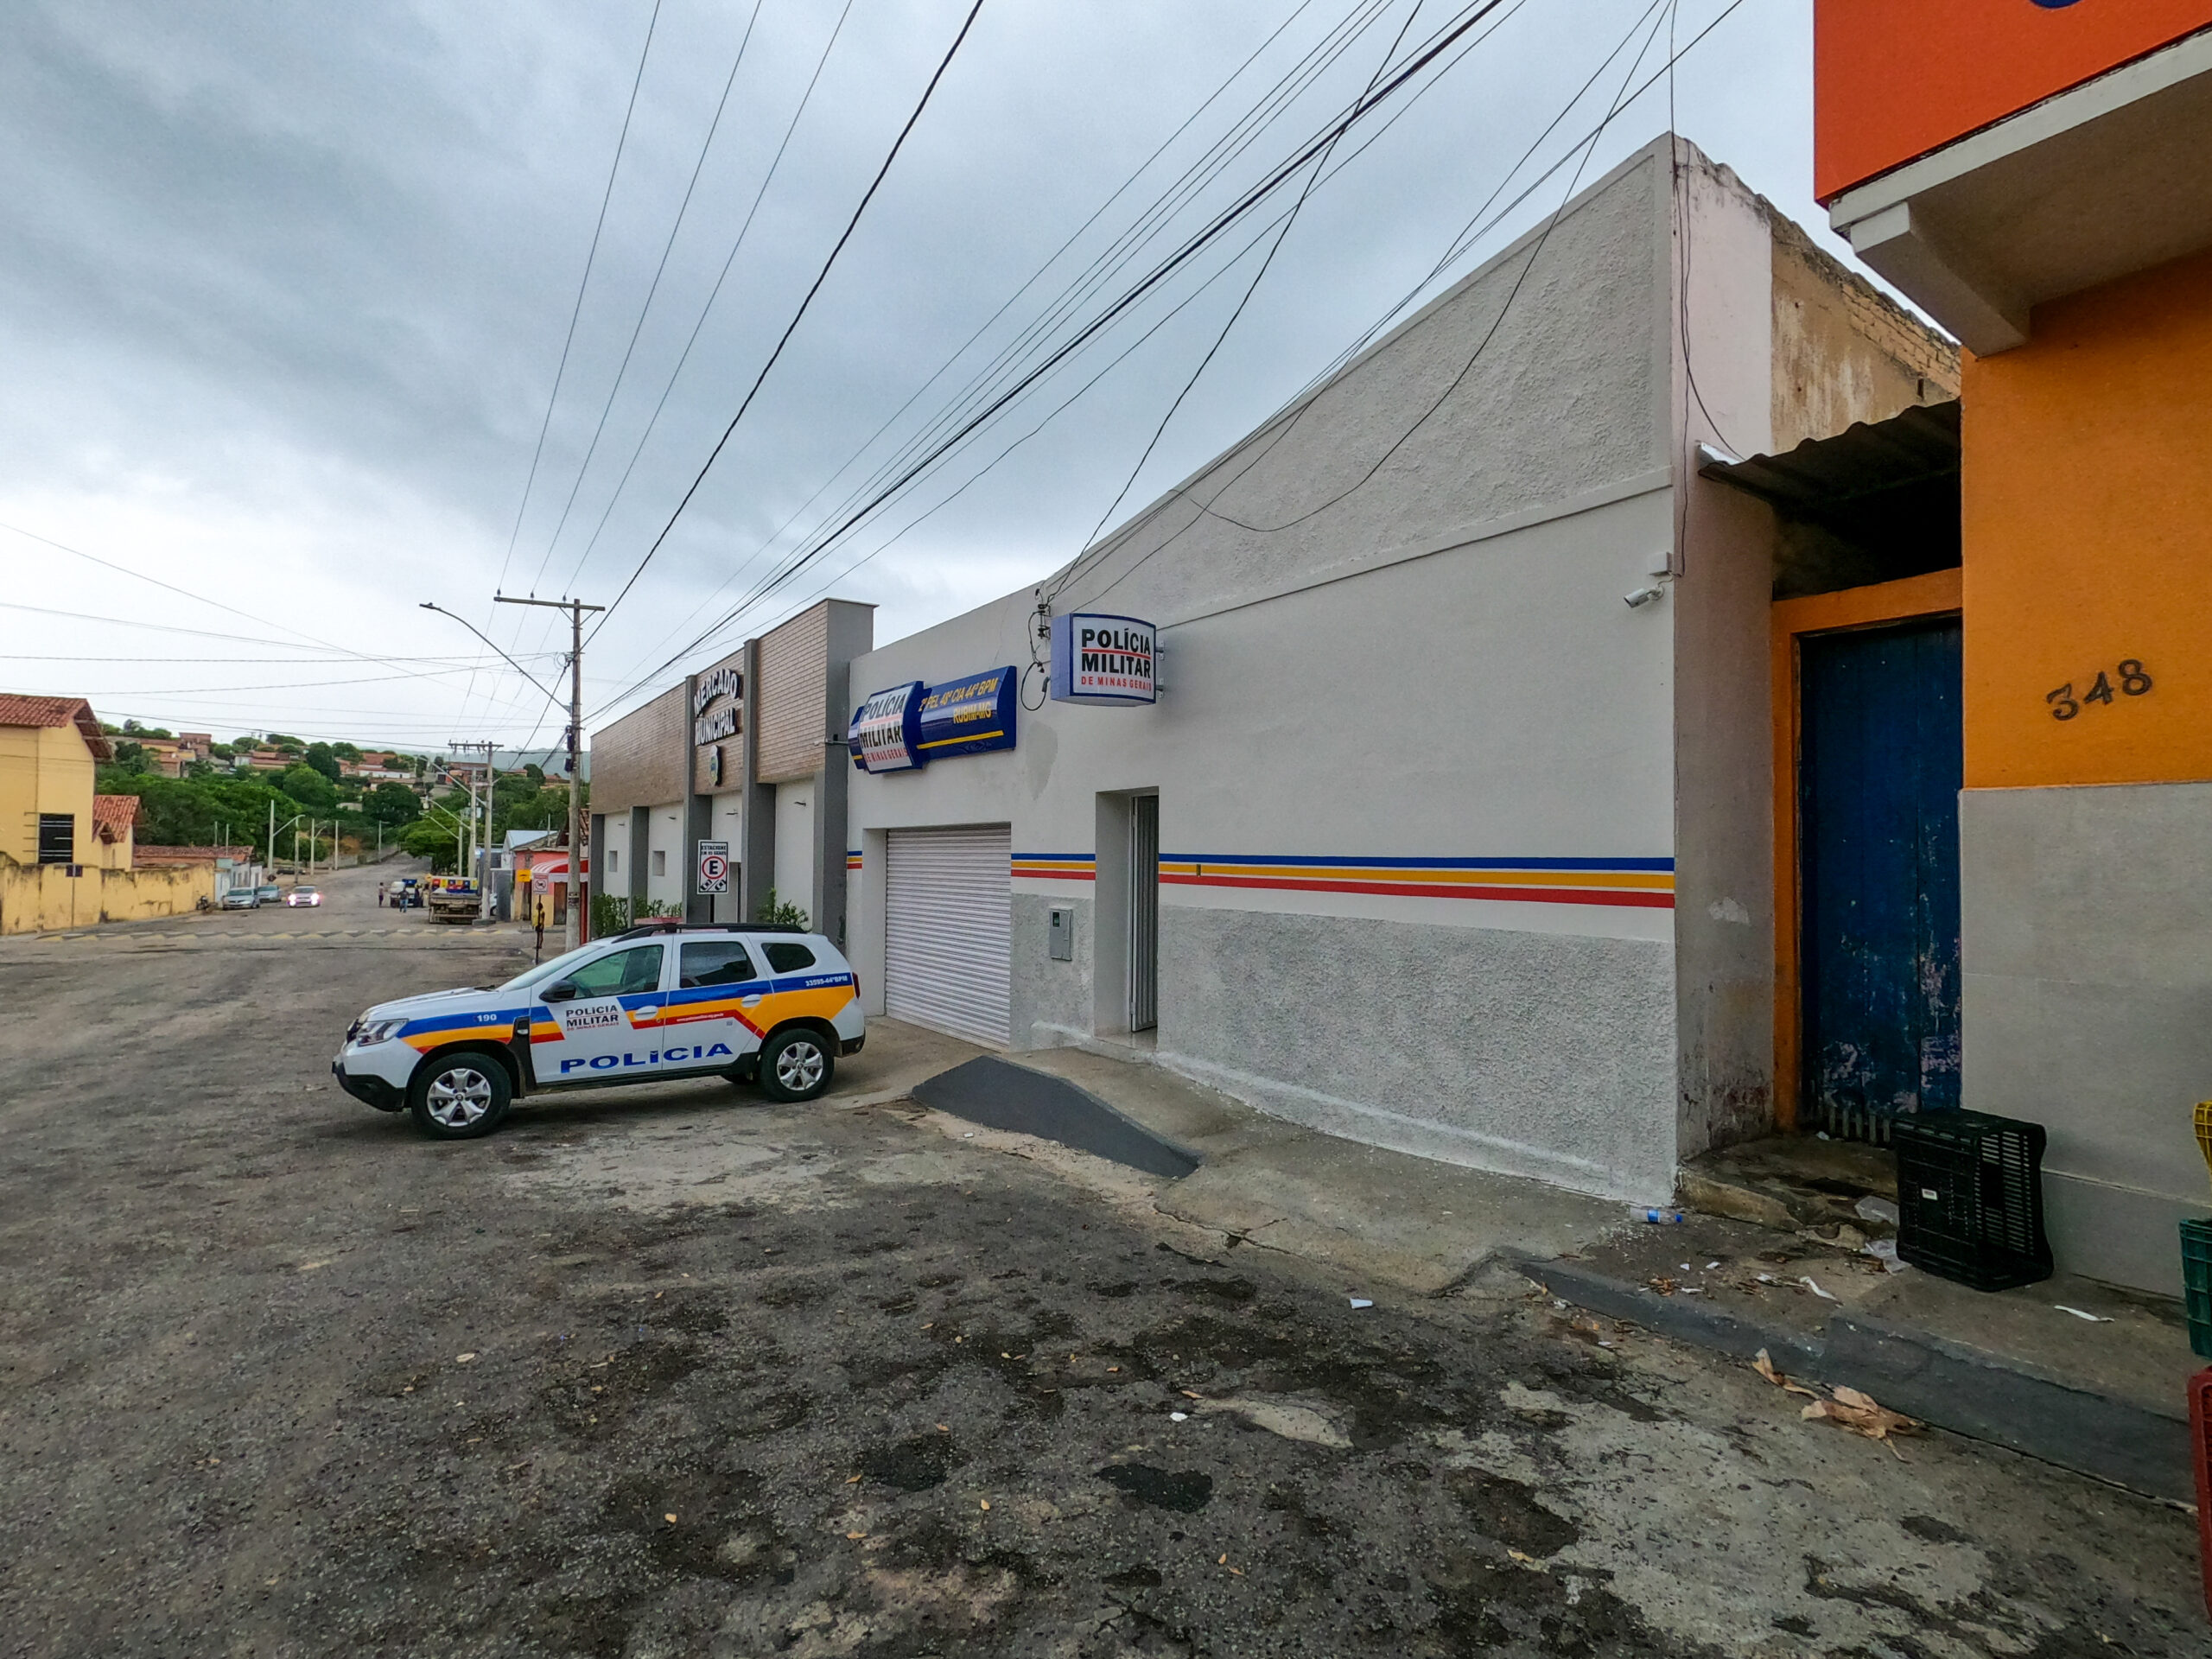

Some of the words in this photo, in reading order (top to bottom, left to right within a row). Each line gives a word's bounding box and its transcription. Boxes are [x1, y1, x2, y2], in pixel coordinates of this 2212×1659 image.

[1081, 628, 1151, 655] POLÍCIA
[1081, 652, 1151, 679] MILITAR
[694, 668, 738, 718] MERCADO
[926, 695, 940, 709] PEL
[977, 677, 999, 696] BPM
[1081, 676, 1094, 685] DE
[1097, 677, 1127, 688] MINAS
[1129, 679, 1152, 692] GERAIS
[2046, 659, 2152, 721] 348
[863, 694, 906, 720] POLÍCIA
[953, 701, 993, 724] RUBIM-MG
[695, 707, 735, 747] MUNICIPAL
[860, 721, 902, 749] MILITAR
[709, 860, 719, 874] E
[477, 1014, 498, 1022] 190
[566, 1014, 620, 1027] MILITAR
